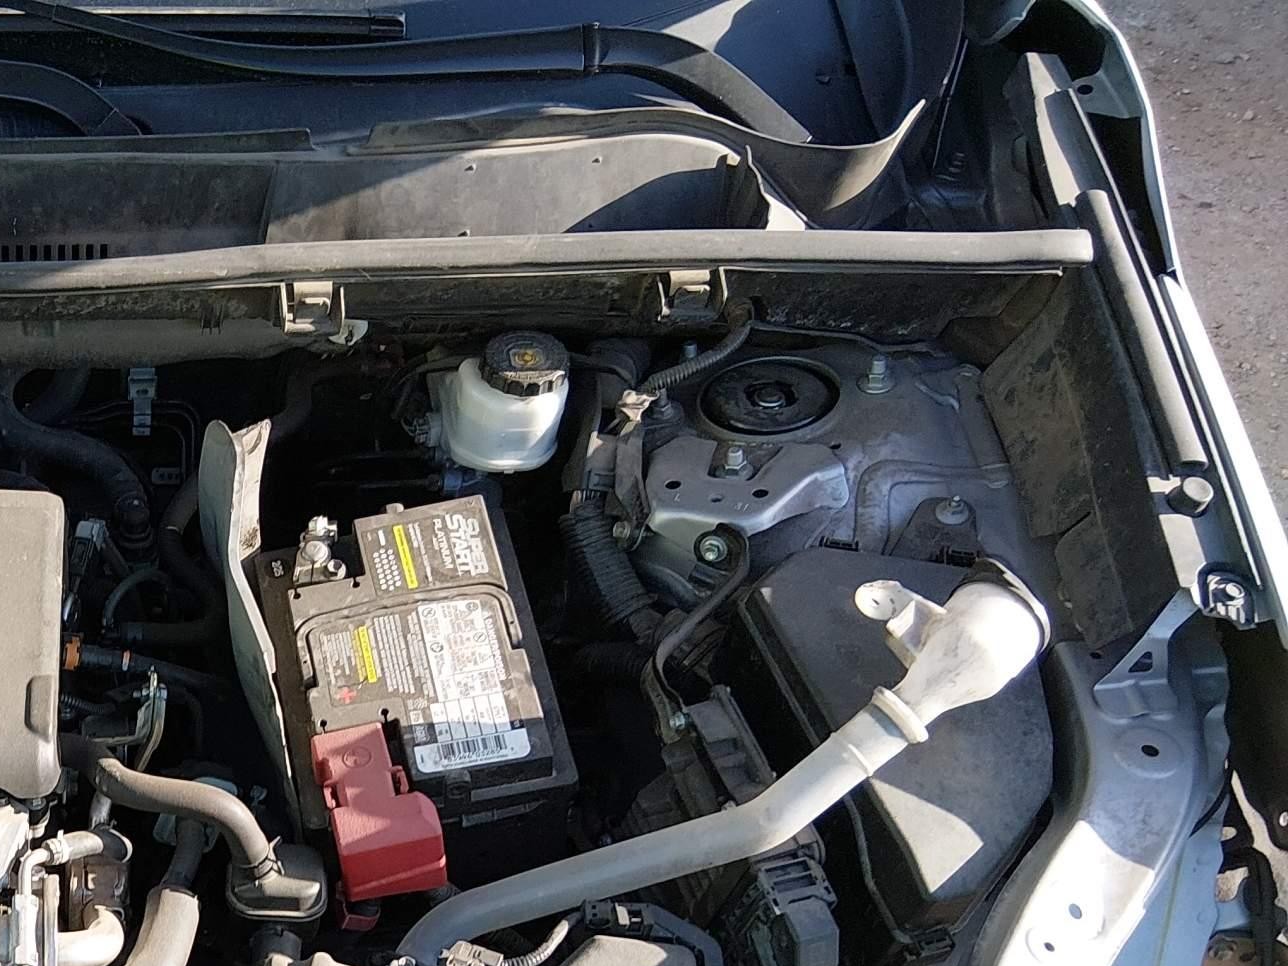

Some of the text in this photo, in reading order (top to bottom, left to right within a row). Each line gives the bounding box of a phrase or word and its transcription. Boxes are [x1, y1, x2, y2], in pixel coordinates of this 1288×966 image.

[433, 518, 454, 569] PLATINUM
[444, 514, 472, 574] START
[464, 518, 489, 576] SUPER
